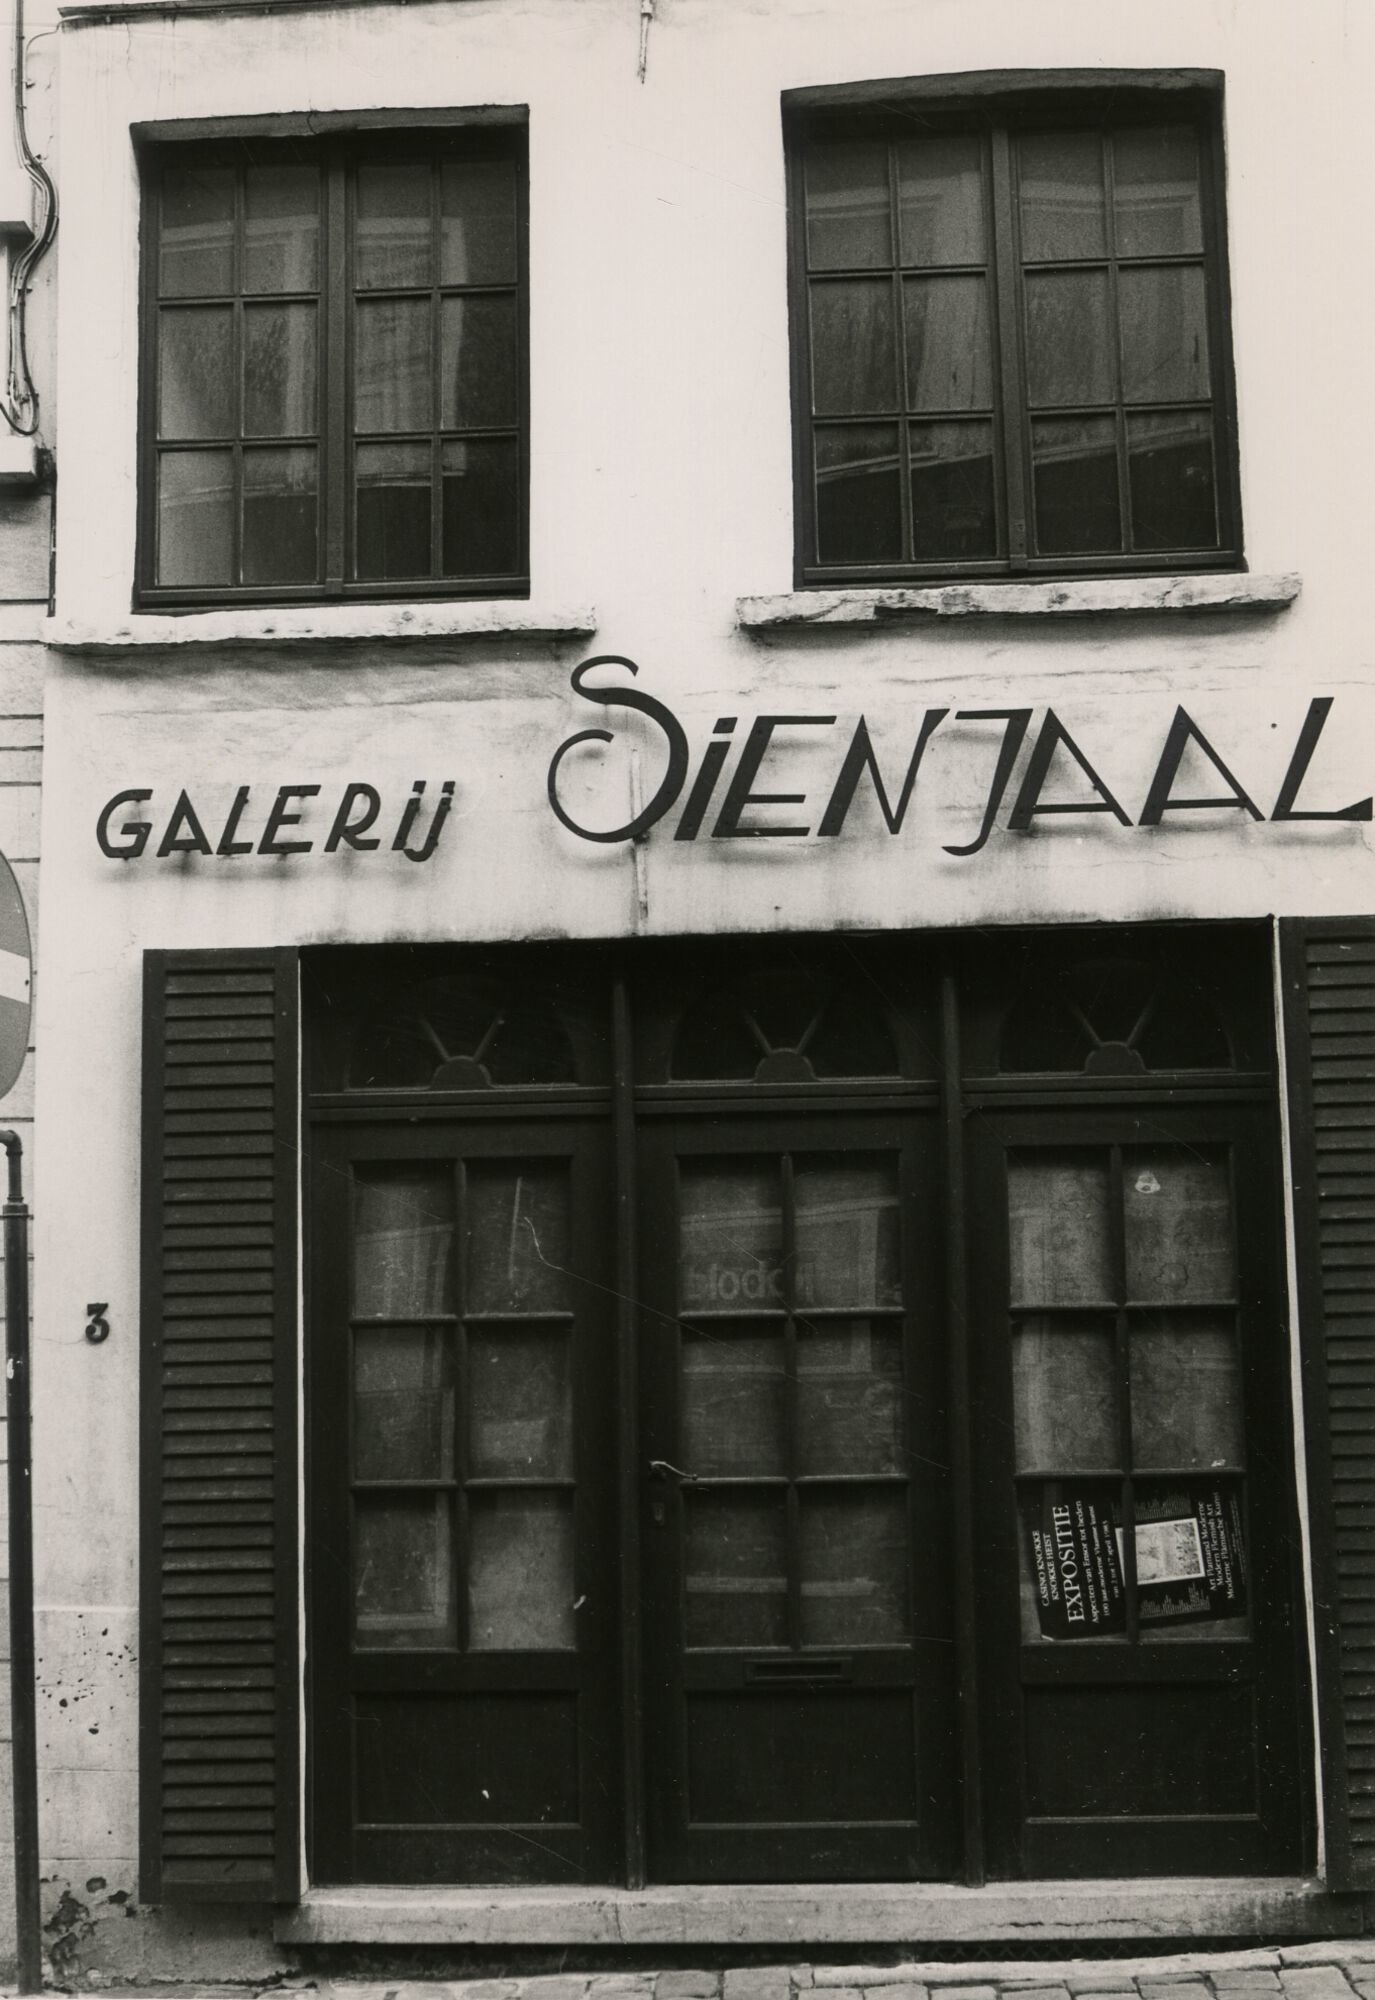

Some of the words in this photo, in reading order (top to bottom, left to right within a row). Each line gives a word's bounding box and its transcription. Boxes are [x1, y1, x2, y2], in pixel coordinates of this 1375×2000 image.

[85, 1303, 110, 1343] 3
[1075, 1500, 1084, 1527] heden
[1197, 1502, 1207, 1539] Moderne
[1206, 1504, 1214, 1516] Art
[1033, 1530, 1044, 1570] KNOKKE
[1043, 1533, 1054, 1559] HEIST
[1209, 1518, 1218, 1551] Flemish
[1052, 1505, 1085, 1622] EXPOSITIE
[1082, 1543, 1090, 1566] Ensor
[1203, 1541, 1214, 1576] Flamand
[1214, 1553, 1224, 1586] Modern
[1039, 1572, 1049, 1606] CASINO
[1048, 1561, 1059, 1600] KNOKKE
[1209, 1578, 1217, 1591] Art
[1224, 1561, 1234, 1599] Moderne
[1088, 1585, 1100, 1623] Aspecten
